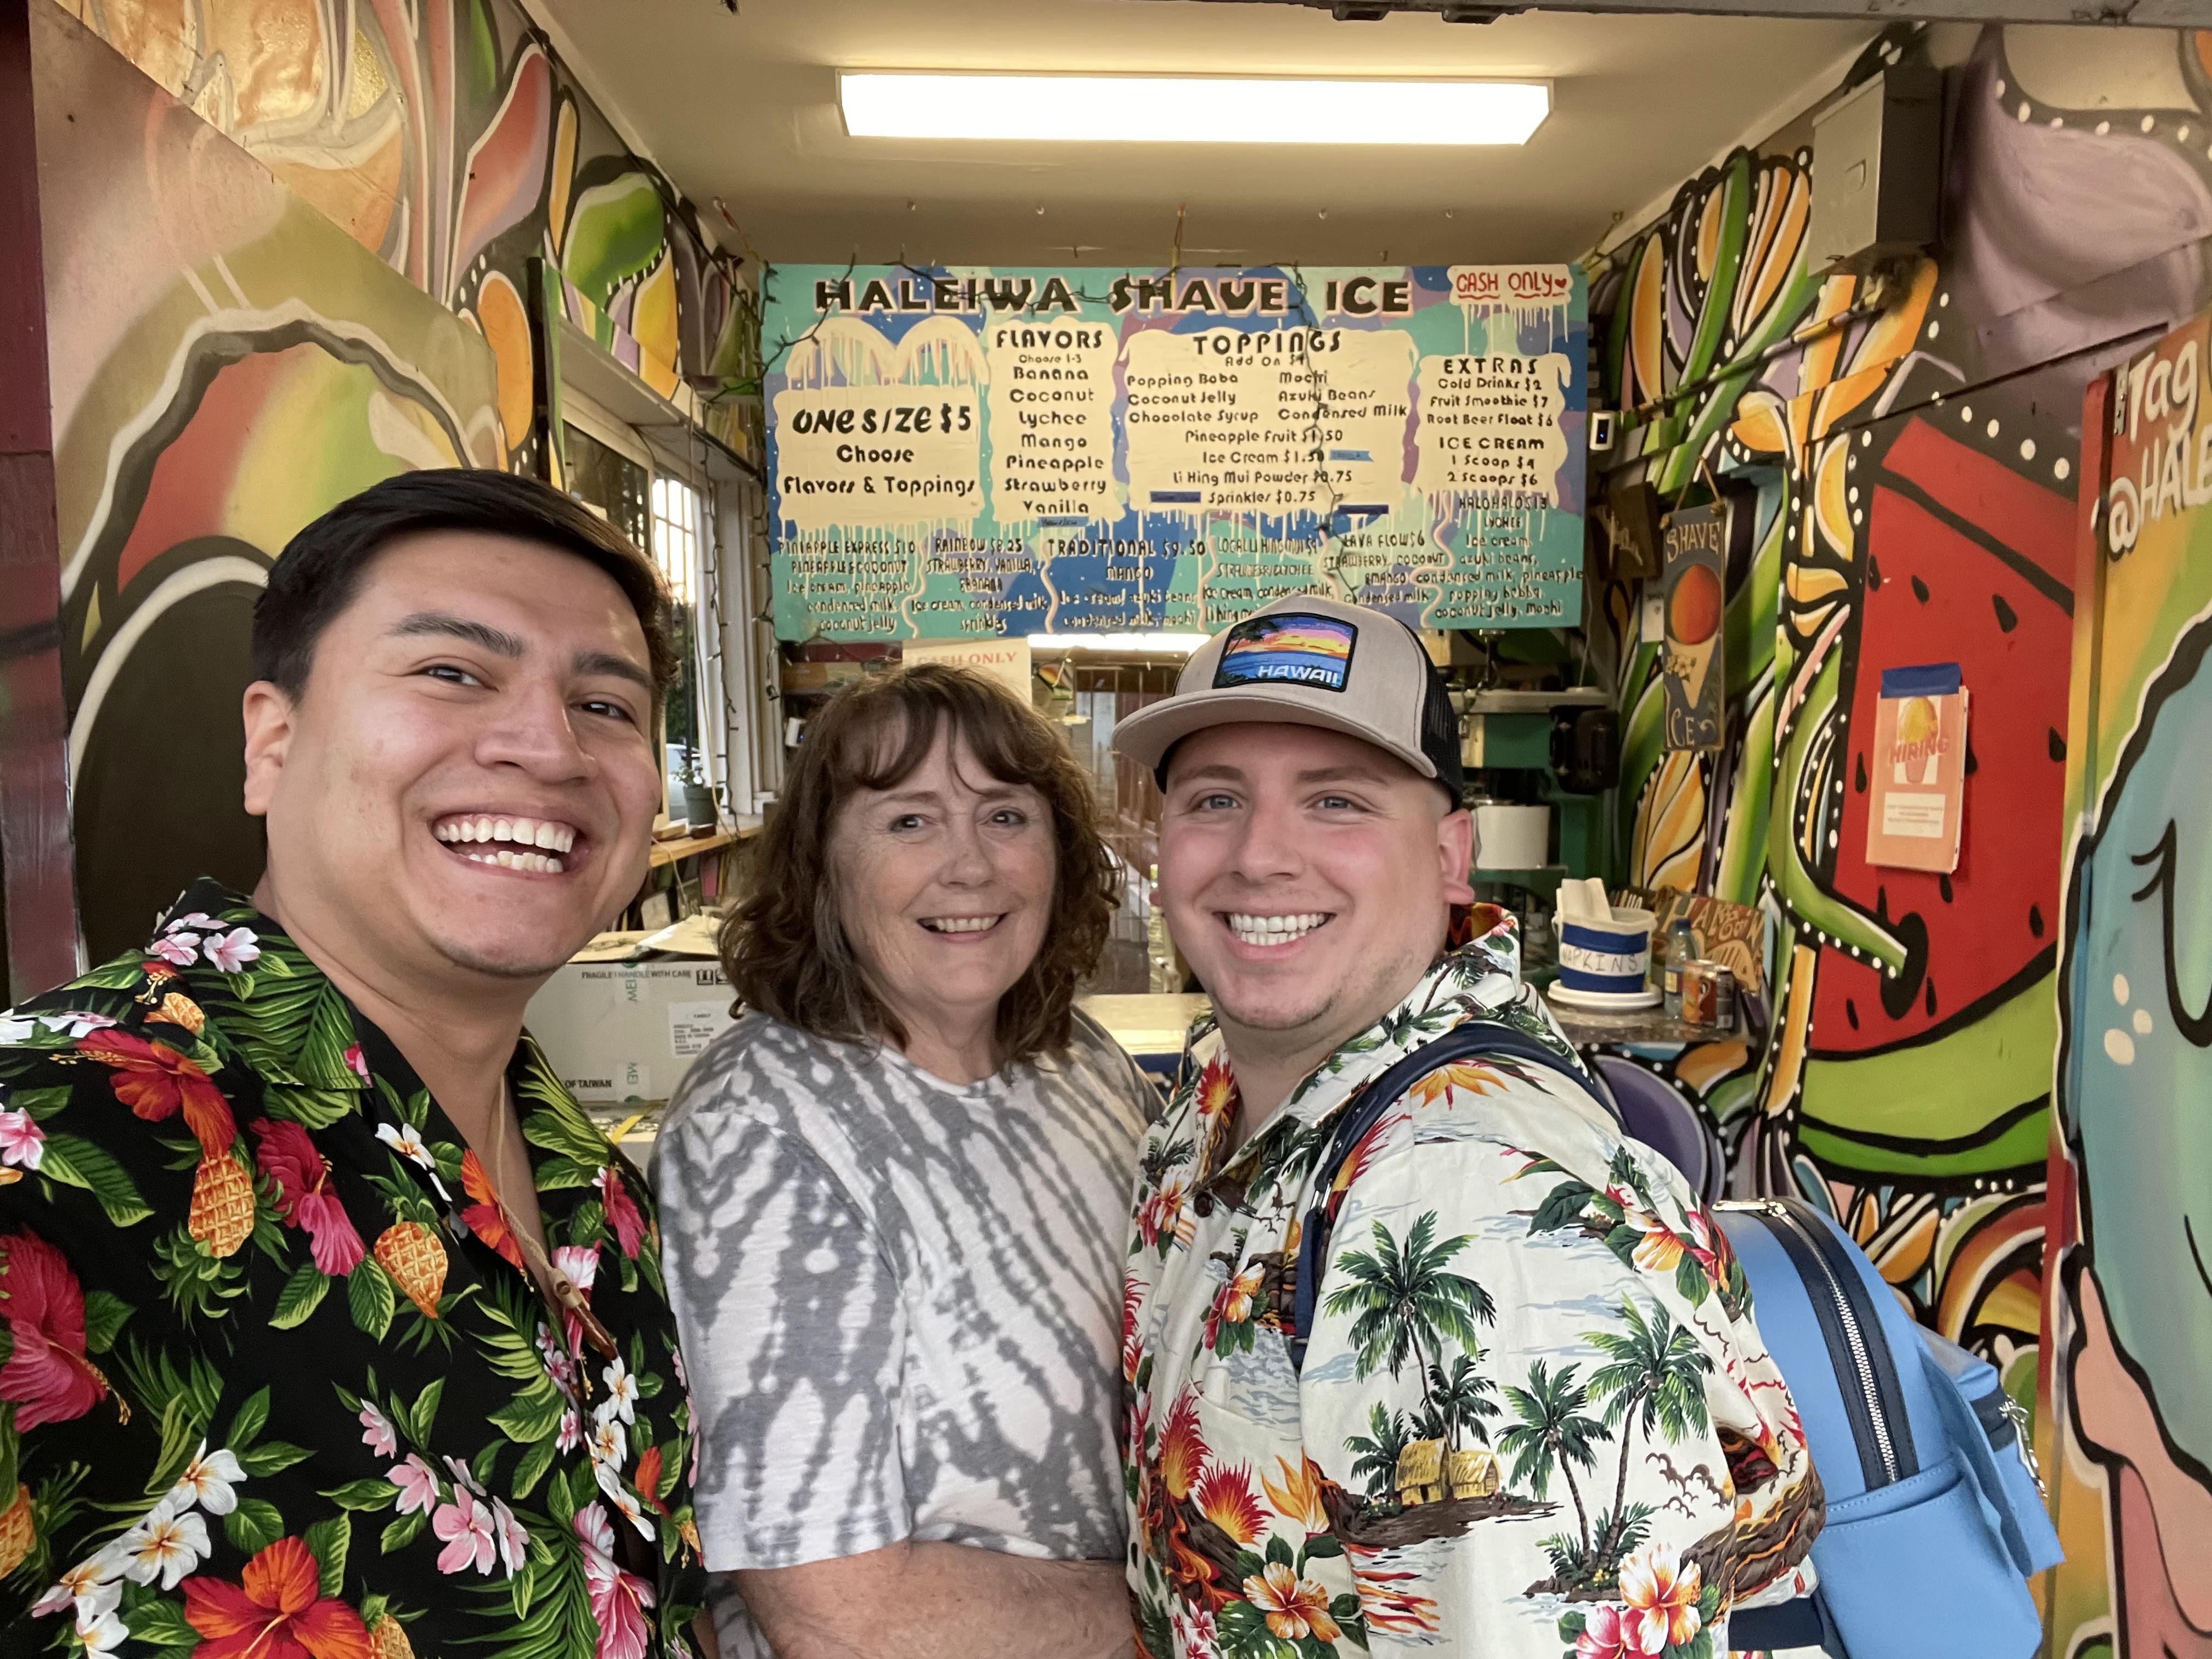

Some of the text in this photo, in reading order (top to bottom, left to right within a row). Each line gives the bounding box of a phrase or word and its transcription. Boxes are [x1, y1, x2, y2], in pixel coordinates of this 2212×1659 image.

[1456, 271, 1552, 297] CASH ONLY
[814, 276, 1410, 314] HALEIWA SHAVE ICE
[996, 329, 1103, 349] FLAVORS
[1193, 330, 1341, 355] TOPPINGS
[1018, 354, 1082, 364] Choose 1-3
[1224, 356, 1254, 367] Add
[1261, 356, 1280, 366] On
[1443, 357, 1538, 374] EXTRAS
[1013, 366, 1089, 380] Banana
[1126, 373, 1238, 388] Popping Boba
[1437, 376, 1542, 392] Cold Drinks $2
[2129, 340, 2198, 443] Tag
[1009, 387, 1095, 403] Coconut
[1127, 390, 1236, 406] Coconut Jelly
[1278, 388, 1376, 402] Azuki Beans
[1430, 393, 1549, 408] Fruit Smoothie $7
[861, 407, 932, 433] SIZE
[1018, 410, 1087, 428] Lychee
[1129, 409, 1259, 424] Chocolate Syrup
[1278, 404, 1407, 420] Condensed Milk
[1427, 412, 1553, 427] Root Beer Float $6
[1021, 433, 1087, 451] Mango
[1185, 429, 1260, 445] Pineapple
[1439, 436, 1544, 450] ICE CREAM
[836, 444, 915, 462] Choose
[1203, 451, 1226, 464] Ice
[1231, 451, 1278, 464] Cream
[1006, 454, 1104, 473] Pineapple
[1452, 454, 1456, 465] 1
[1464, 454, 1510, 470] Scoop
[783, 474, 975, 497] Flavors & Toppings
[1187, 471, 1218, 486] Hing
[1224, 470, 1249, 484] Mui
[1255, 471, 1308, 483] Powder
[1447, 471, 1538, 487] 2 Scoops $6
[1005, 478, 1107, 495] Strawberry
[1207, 489, 1316, 506] Sprinkles $0.75
[1023, 499, 1089, 514] Vanilla
[779, 540, 839, 555] PINEAPPLE
[845, 540, 890, 554] EXPRESS
[935, 538, 986, 553] RAINBOW
[1048, 538, 1206, 559] TRADITIONAL $9.50
[1343, 533, 1373, 548] LAVA
[1378, 533, 1408, 547] FLOW
[1666, 522, 1720, 563] SHAVE
[791, 560, 847, 574] PINEAPPLE
[856, 560, 908, 574] COCONUT
[1396, 552, 1445, 567] COCONUT
[1107, 566, 1154, 580] MANGO
[969, 652, 1017, 665] ONLY
[1258, 664, 1338, 684] HAWAII
[1666, 708, 1695, 747] ICE
[1888, 733, 1949, 763] HIRING
[1562, 947, 1638, 972] NAPKINS
[672, 970, 691, 979] CARE
[578, 1079, 612, 1088] TAIWAN
